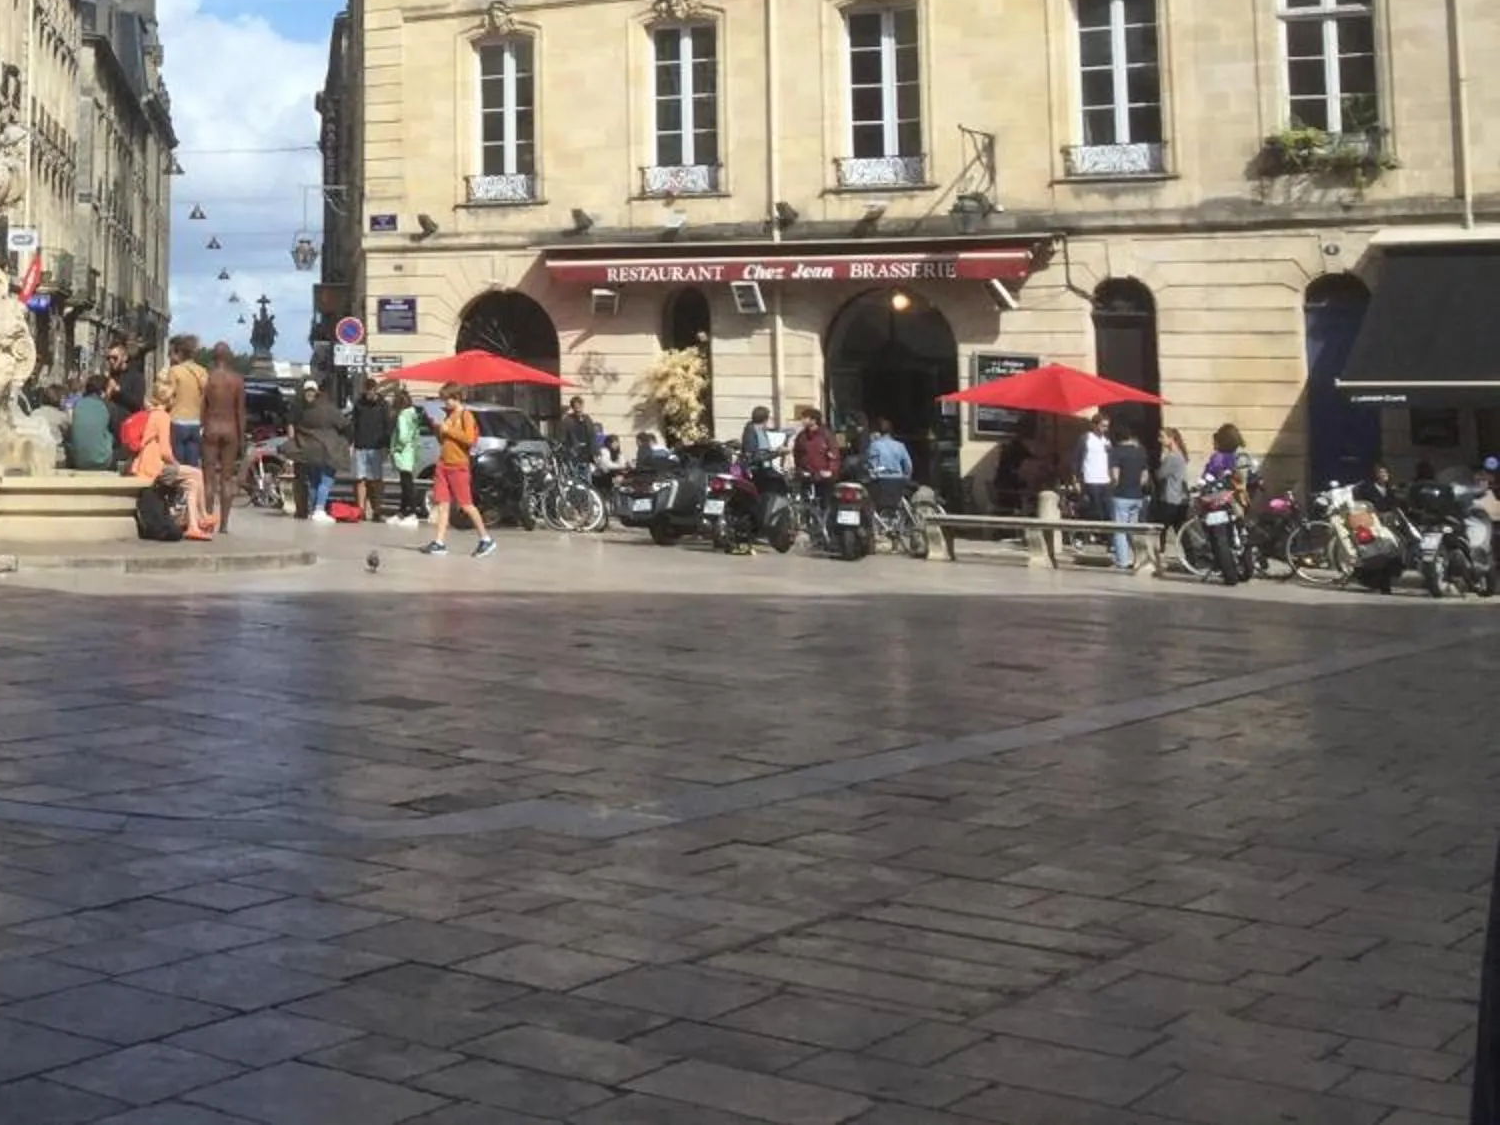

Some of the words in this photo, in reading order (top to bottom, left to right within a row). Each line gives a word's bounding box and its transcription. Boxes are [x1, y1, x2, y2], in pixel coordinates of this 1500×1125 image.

[607, 265, 725, 282] RESTAURANT
[742, 263, 785, 280] Chez
[791, 263, 834, 280] Jean
[850, 261, 957, 279] BRASSERIE
